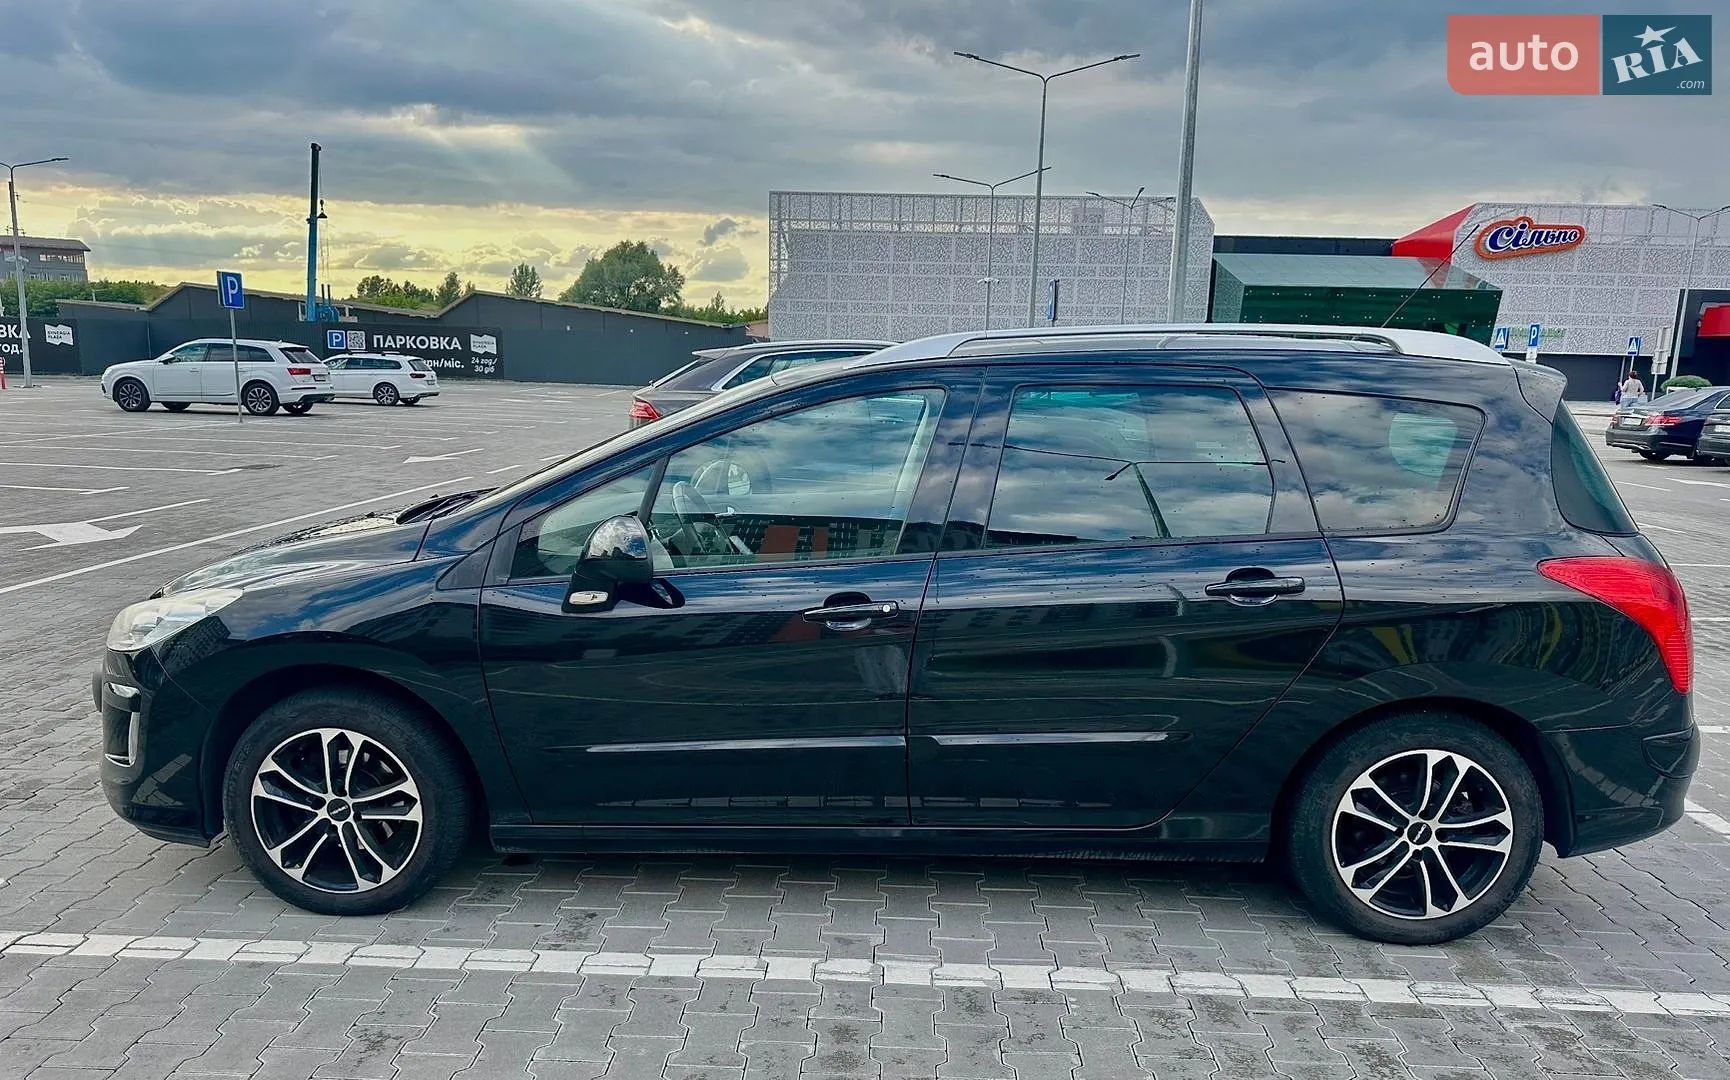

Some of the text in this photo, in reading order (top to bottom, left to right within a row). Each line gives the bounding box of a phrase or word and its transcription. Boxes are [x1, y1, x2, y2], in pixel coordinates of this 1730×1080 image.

[1487, 222, 1581, 252] Сільпо
[227, 276, 238, 304] P
[332, 333, 342, 347] P
[373, 334, 463, 350] ПАРКОВКА
[1530, 326, 1538, 345] P
[0, 343, 24, 355] од.
[424, 358, 465, 369] рн/міс.
[471, 356, 480, 364] 24
[474, 365, 484, 373] 30
